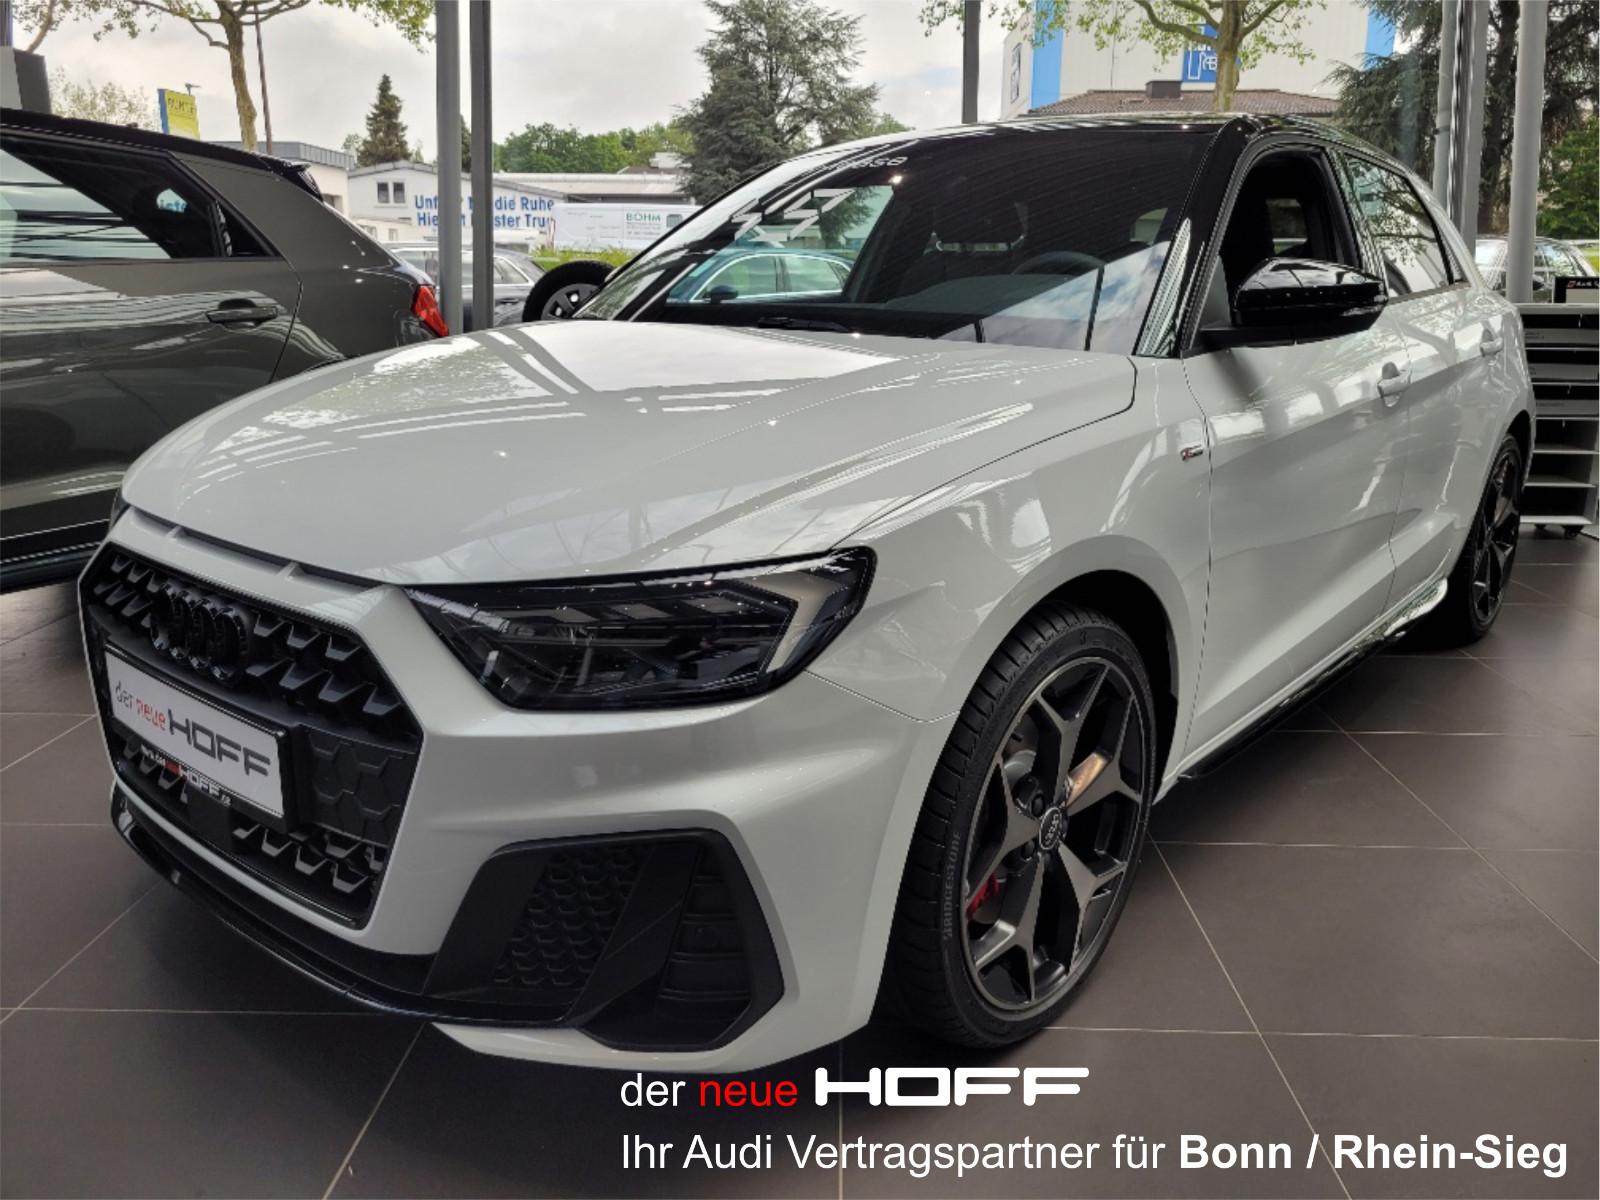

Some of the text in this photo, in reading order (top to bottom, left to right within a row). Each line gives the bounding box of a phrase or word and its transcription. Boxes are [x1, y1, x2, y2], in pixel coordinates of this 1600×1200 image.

[495, 196, 516, 210] die
[520, 196, 554, 211] Ruhe
[116, 680, 133, 709] der
[137, 697, 166, 731] neue
[168, 708, 271, 776] HOFF
[943, 831, 961, 940] BRIDGESTONE
